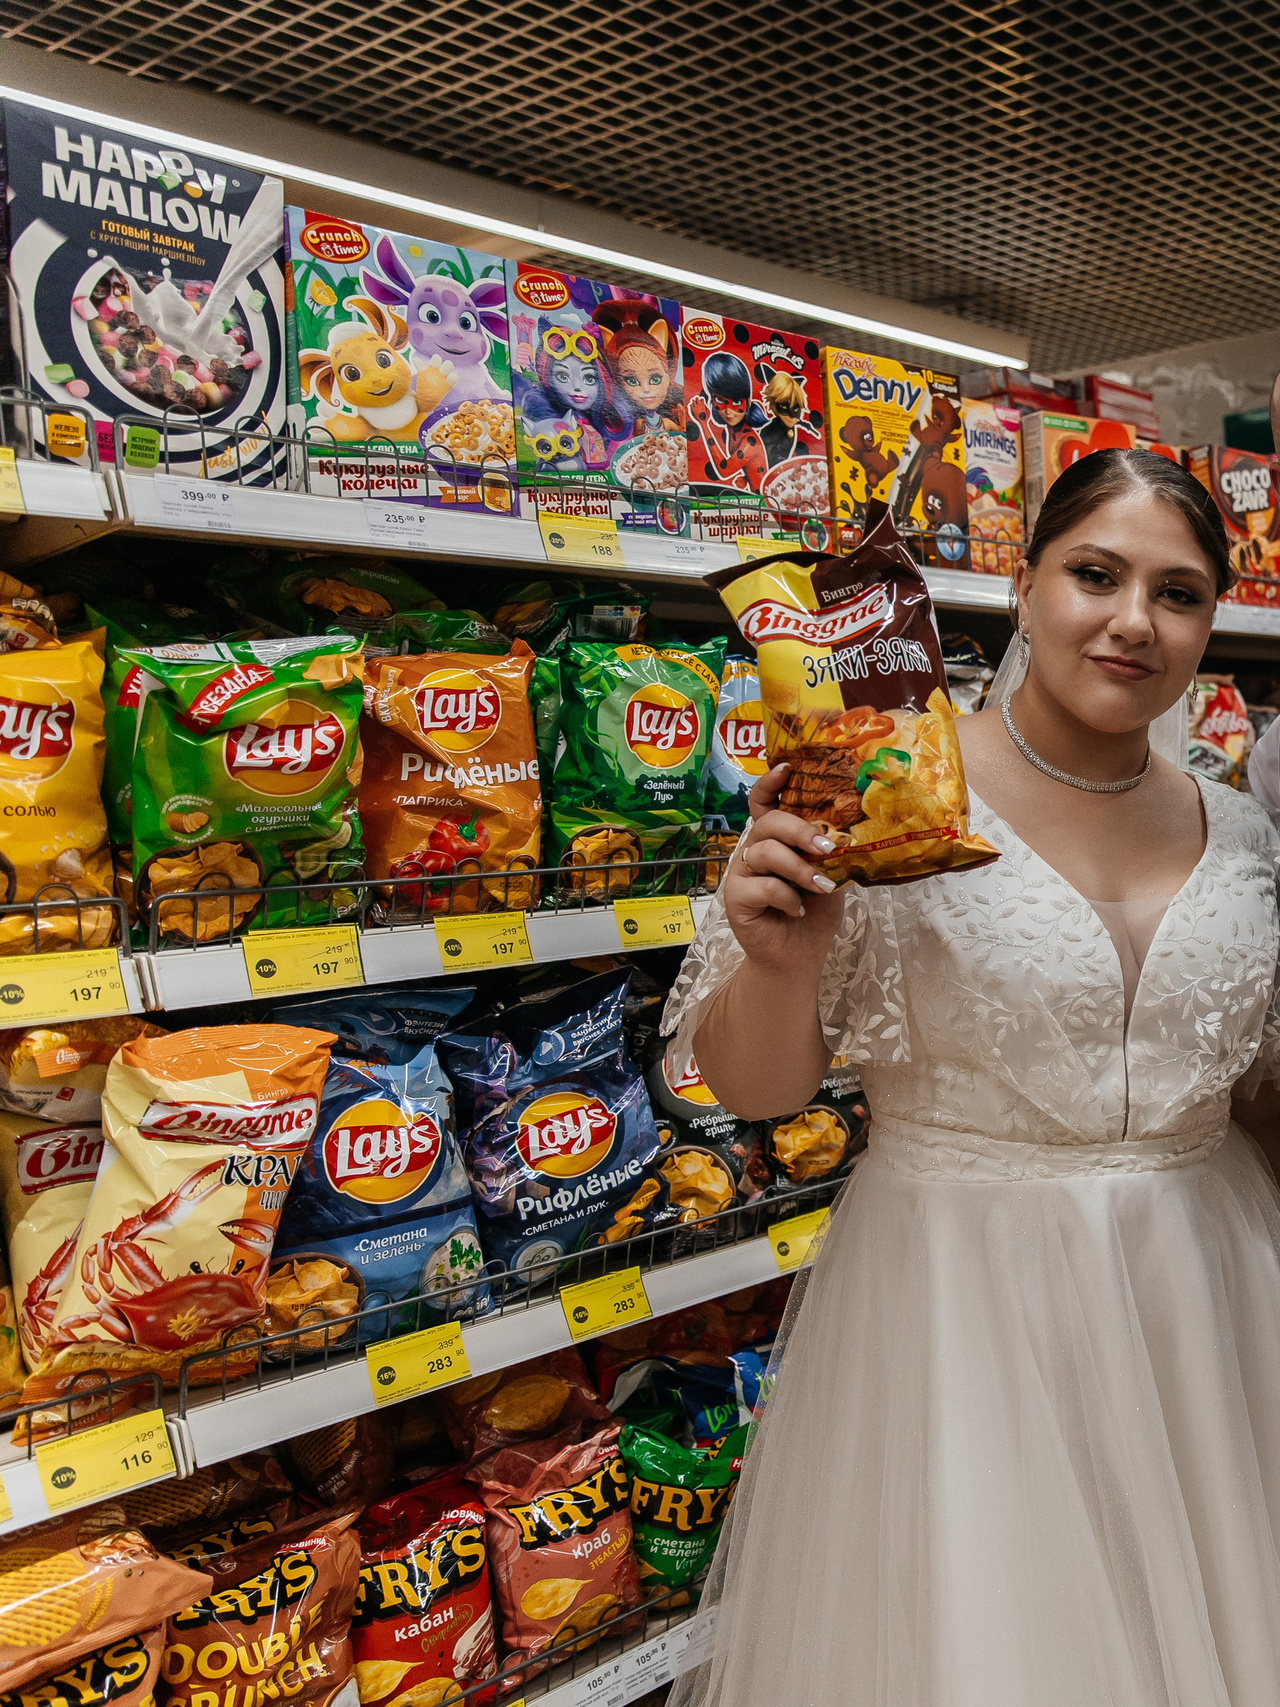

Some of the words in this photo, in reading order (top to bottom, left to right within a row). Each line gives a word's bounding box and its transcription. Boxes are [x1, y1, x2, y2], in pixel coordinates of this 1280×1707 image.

[54, 126, 227, 204] HAPPY
[41, 162, 242, 245] MALLOW
[102, 219, 150, 241] ГОТОВЫЙ
[152, 232, 195, 253] ЗАВТРАК
[307, 230, 362, 244] Crunch
[90, 230, 96, 240] С
[99, 233, 150, 253] ХРУСТЯЩИМ
[152, 245, 206, 267] МАРШМЕЛЛОУ
[332, 242, 360, 255] time
[519, 279, 564, 293] Crunch
[540, 291, 563, 303] time
[686, 324, 719, 335] Crunch
[832, 368, 922, 412] Denny
[53, 424, 79, 433] ЖЕЛЕЗО
[318, 459, 430, 480] Кукурузные
[341, 475, 419, 492] колечки
[1220, 470, 1272, 493] CHOCO
[526, 488, 618, 506] Кукурузные
[693, 511, 769, 530] Кукурузные
[600, 532, 614, 541] 235
[708, 524, 760, 537] шарики
[591, 544, 613, 557] 188
[820, 582, 864, 604] Бингрэ
[743, 592, 887, 641] Binggrae
[631, 646, 653, 656] ЛЕТО
[700, 668, 719, 694] LAY'S
[801, 637, 933, 690] ЗЯКИ-ЗЯКИ
[422, 685, 496, 734] Lay's
[0, 702, 70, 760] ay's
[630, 701, 693, 750] Lay's
[232, 719, 336, 775] Lay's
[727, 720, 767, 761] Lay
[400, 752, 540, 789] Рифлёные
[643, 778, 685, 793] «Зелёный
[393, 793, 468, 808] «ПАПРИКА»
[3, 804, 57, 819] солью
[251, 814, 311, 826] огурчики
[875, 835, 908, 849] ЖАРЕНОЙ
[501, 927, 517, 936] 219
[663, 923, 681, 934] 197
[325, 945, 343, 955] 219
[445, 943, 462, 952] -10%
[492, 942, 514, 955] 197
[518, 938, 527, 946] 90
[86, 968, 107, 979] 219
[256, 964, 277, 973] -10%
[312, 961, 339, 975] 197
[0, 989, 24, 1000] -10%
[69, 986, 102, 1002] 197
[108, 981, 121, 990] 90
[404, 1018, 445, 1029] ФЭНТЕЗИ
[404, 1026, 440, 1037] ВКУСНЕЕ
[257, 1088, 289, 1100] Бингрэ
[155, 1106, 313, 1138] Binggrae
[689, 1112, 741, 1130] «Рёбрышк
[522, 1104, 614, 1161] Lay's
[334, 1120, 433, 1180] Lay's
[221, 1154, 302, 1187] КРА
[516, 1157, 645, 1222] Рифлёные
[522, 1212, 576, 1238] «СМЕТАНА
[576, 1209, 586, 1219] И
[354, 1226, 428, 1253] «Сметана
[361, 1254, 370, 1265] и
[372, 1241, 426, 1261] зелень»
[621, 1282, 635, 1293] 339
[613, 1297, 636, 1314] 283
[636, 1291, 645, 1299] 90
[437, 1338, 454, 1350] 339
[427, 1355, 453, 1374] 283
[455, 1348, 465, 1357] 90
[378, 1370, 396, 1381] -16%
[134, 1430, 154, 1444] 129
[121, 1450, 153, 1471] 116
[156, 1440, 169, 1451] 90
[52, 1471, 77, 1485] -10%
[509, 1458, 629, 1543] FRY'S
[172, 1519, 276, 1572] RY'S
[281, 1535, 327, 1549] НОВИНКА
[572, 1527, 612, 1560] краб
[653, 1537, 706, 1549] сметана
[350, 1526, 486, 1617] FRY'S
[394, 1606, 454, 1642] кабан
